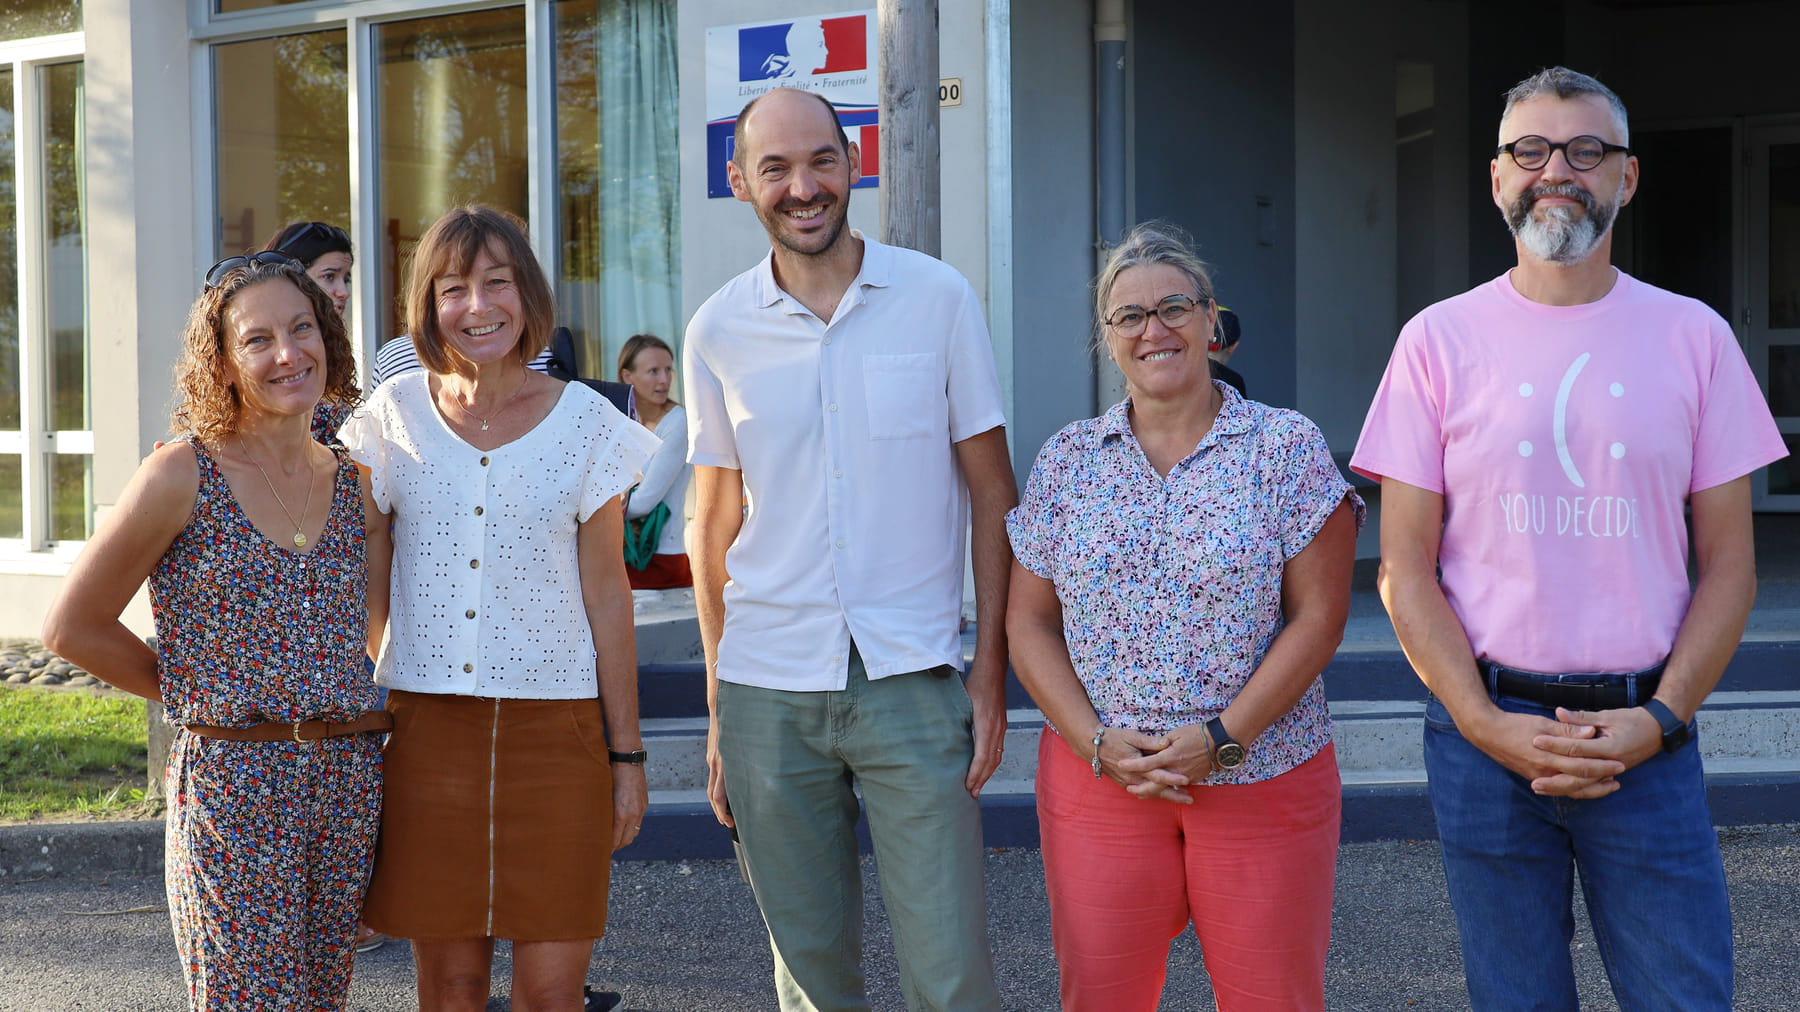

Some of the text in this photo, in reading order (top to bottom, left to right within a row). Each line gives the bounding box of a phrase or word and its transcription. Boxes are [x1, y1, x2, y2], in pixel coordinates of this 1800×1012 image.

[738, 75, 868, 97] Liberté Éalité Fraternité
[1499, 492, 1640, 538] YOU DECIDE
